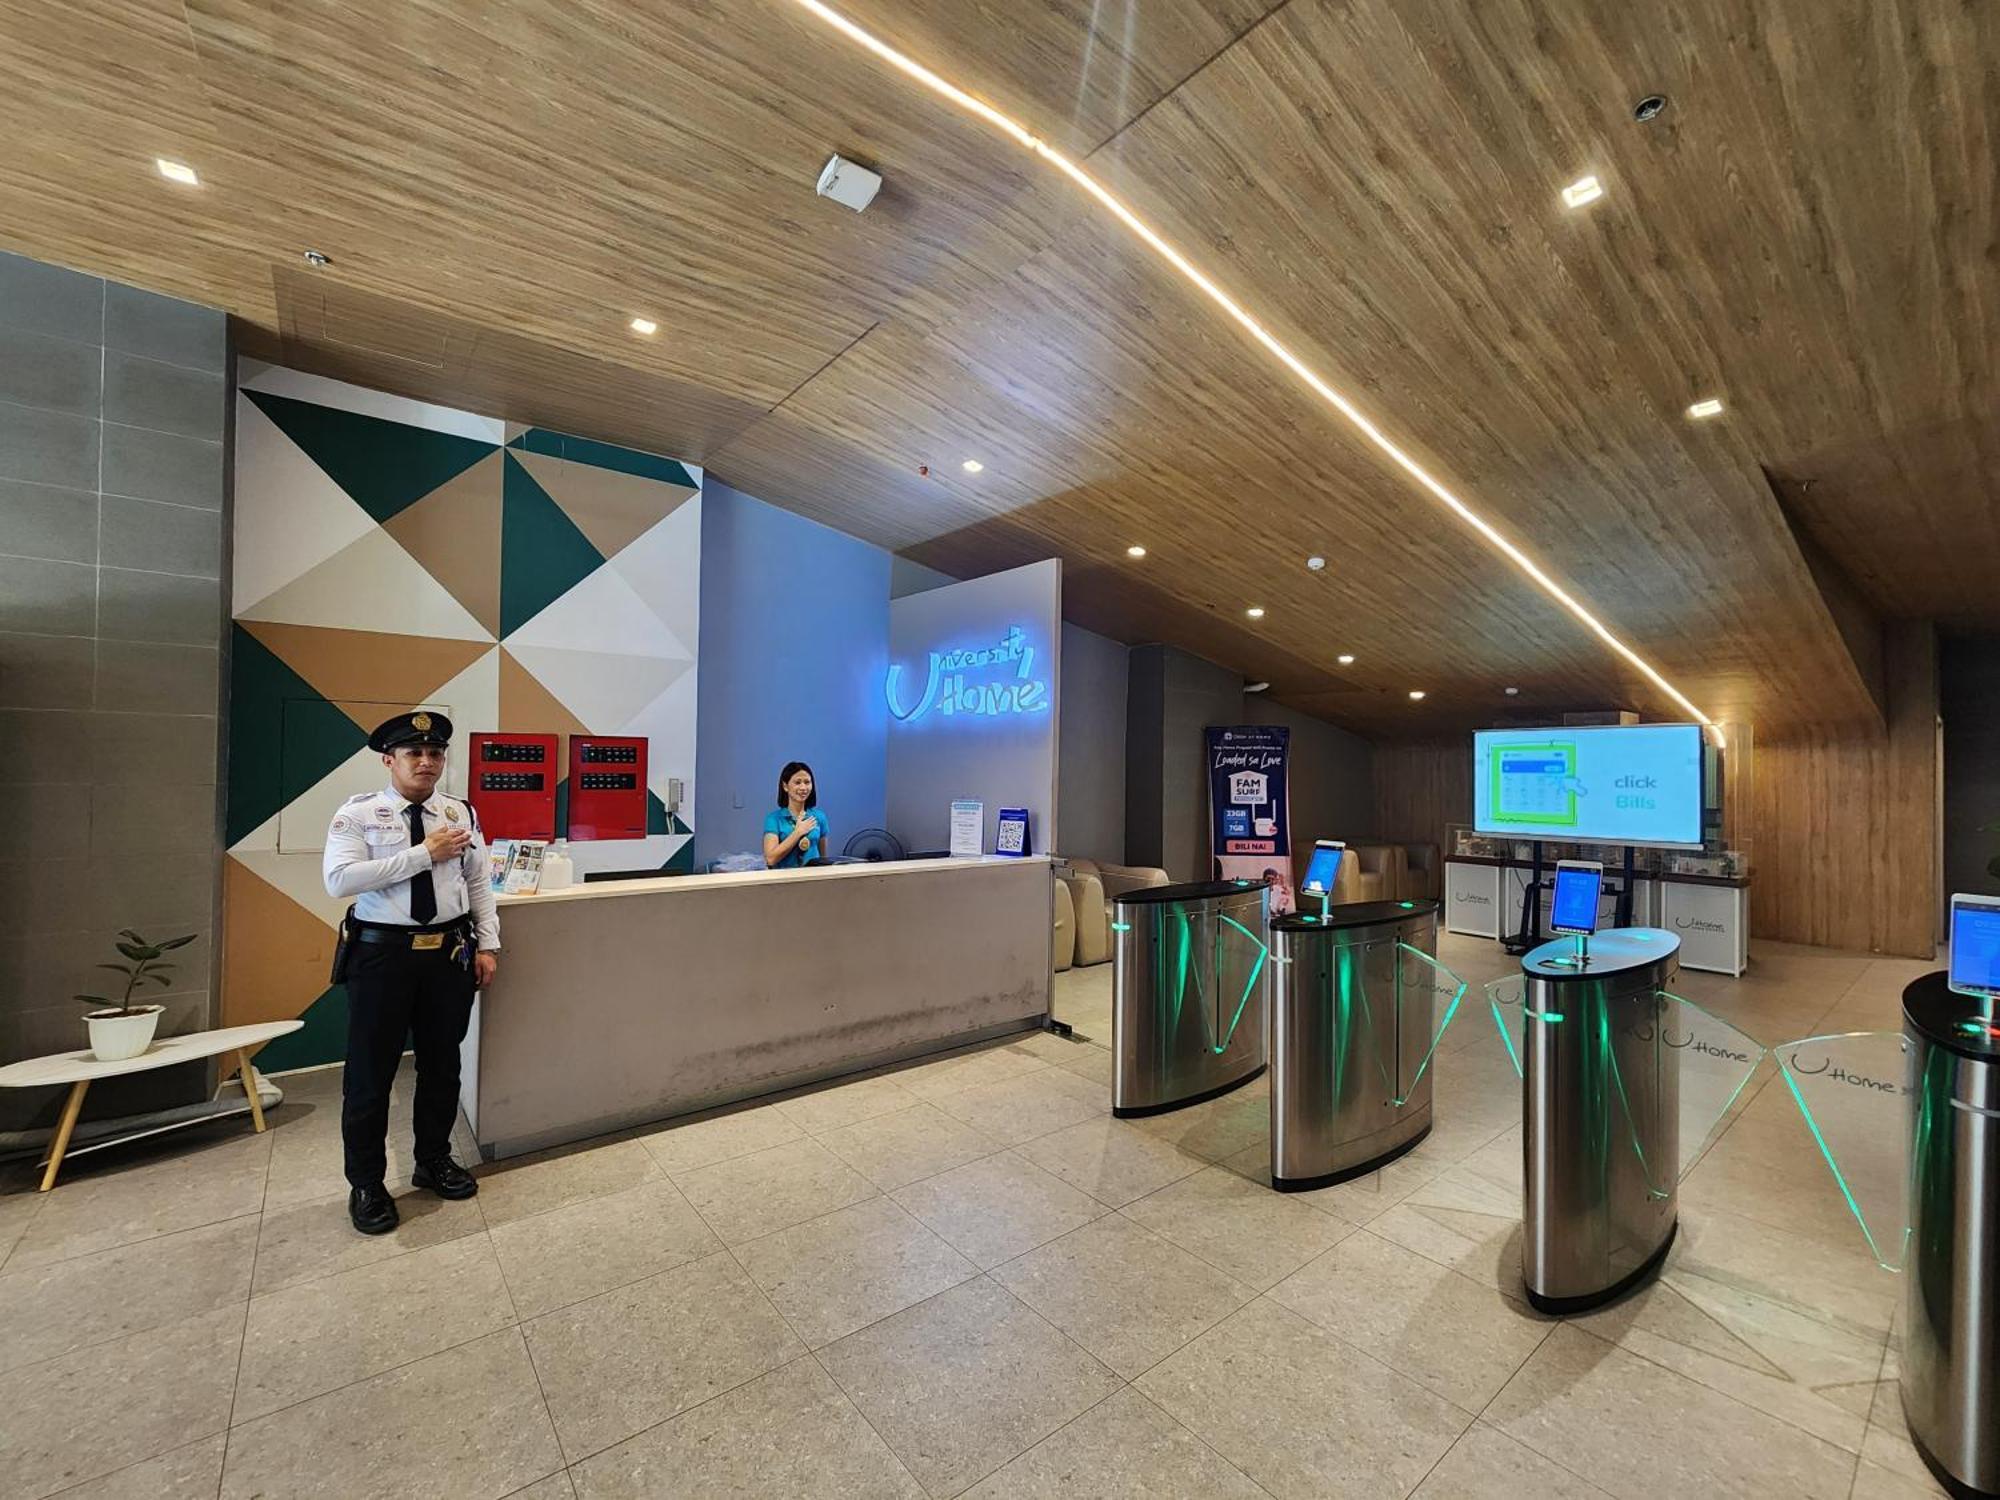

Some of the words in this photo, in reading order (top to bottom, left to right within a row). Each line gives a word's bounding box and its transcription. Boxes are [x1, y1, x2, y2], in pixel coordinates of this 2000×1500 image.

[936, 673, 1048, 716] Home
[1215, 751, 1248, 768] Loaded
[1248, 756, 1259, 766] sa
[1260, 752, 1282, 769] Love
[1236, 779, 1261, 788] FAM
[1614, 775, 1657, 788] click
[1615, 795, 1656, 810] Bills
[1235, 841, 1251, 850] BILI
[1692, 1041, 1749, 1063] Home
[1828, 1067, 1898, 1094] Home
